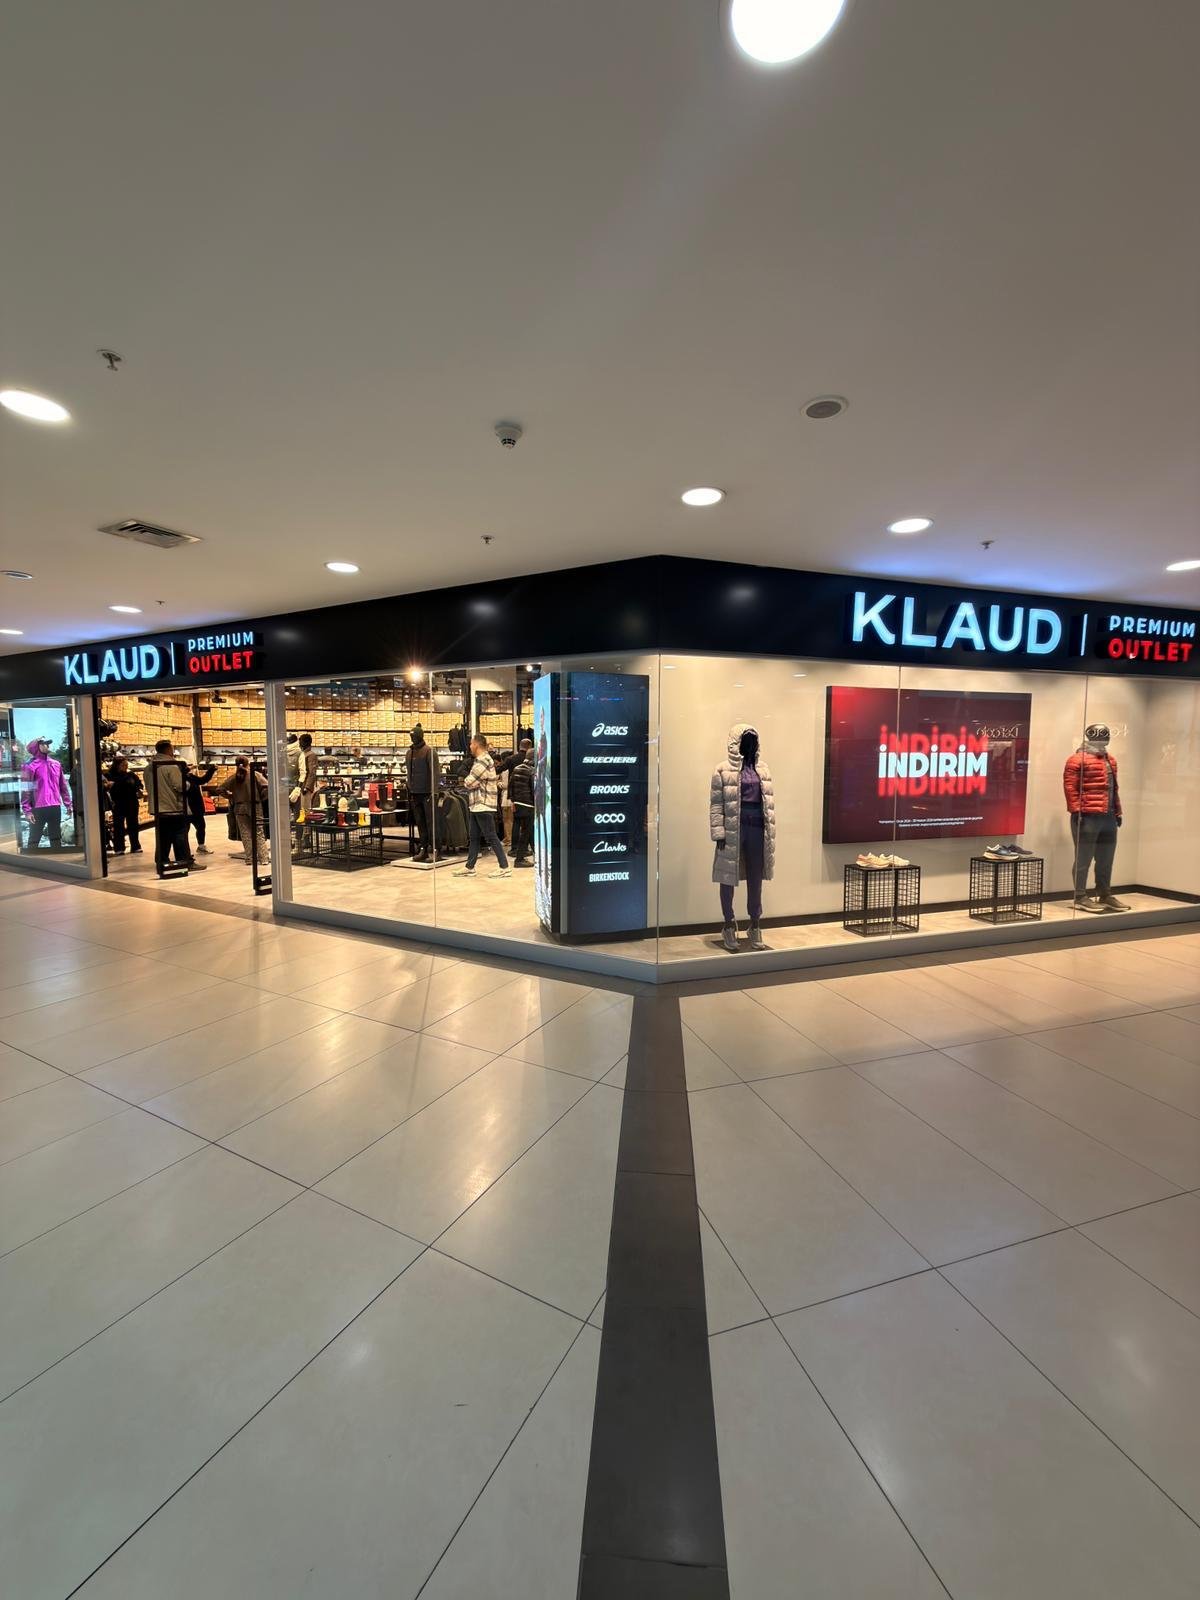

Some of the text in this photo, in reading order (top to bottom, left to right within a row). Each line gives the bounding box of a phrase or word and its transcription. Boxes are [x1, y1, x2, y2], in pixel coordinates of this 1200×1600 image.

[851, 591, 1062, 655] KLAUD
[1109, 615, 1196, 638] PREMIUM
[188, 631, 255, 653] PREMIUM
[1108, 638, 1193, 662] OUTLET
[63, 643, 160, 686] KLAUD
[188, 651, 254, 675] OUTLET
[582, 756, 638, 764] SKECHERS
[878, 743, 989, 778] İNDİRİM
[589, 784, 631, 795] BROOKS
[593, 812, 626, 824] ecco
[592, 840, 627, 854] Clarks
[588, 871, 630, 883] BIRKENSTOCK
